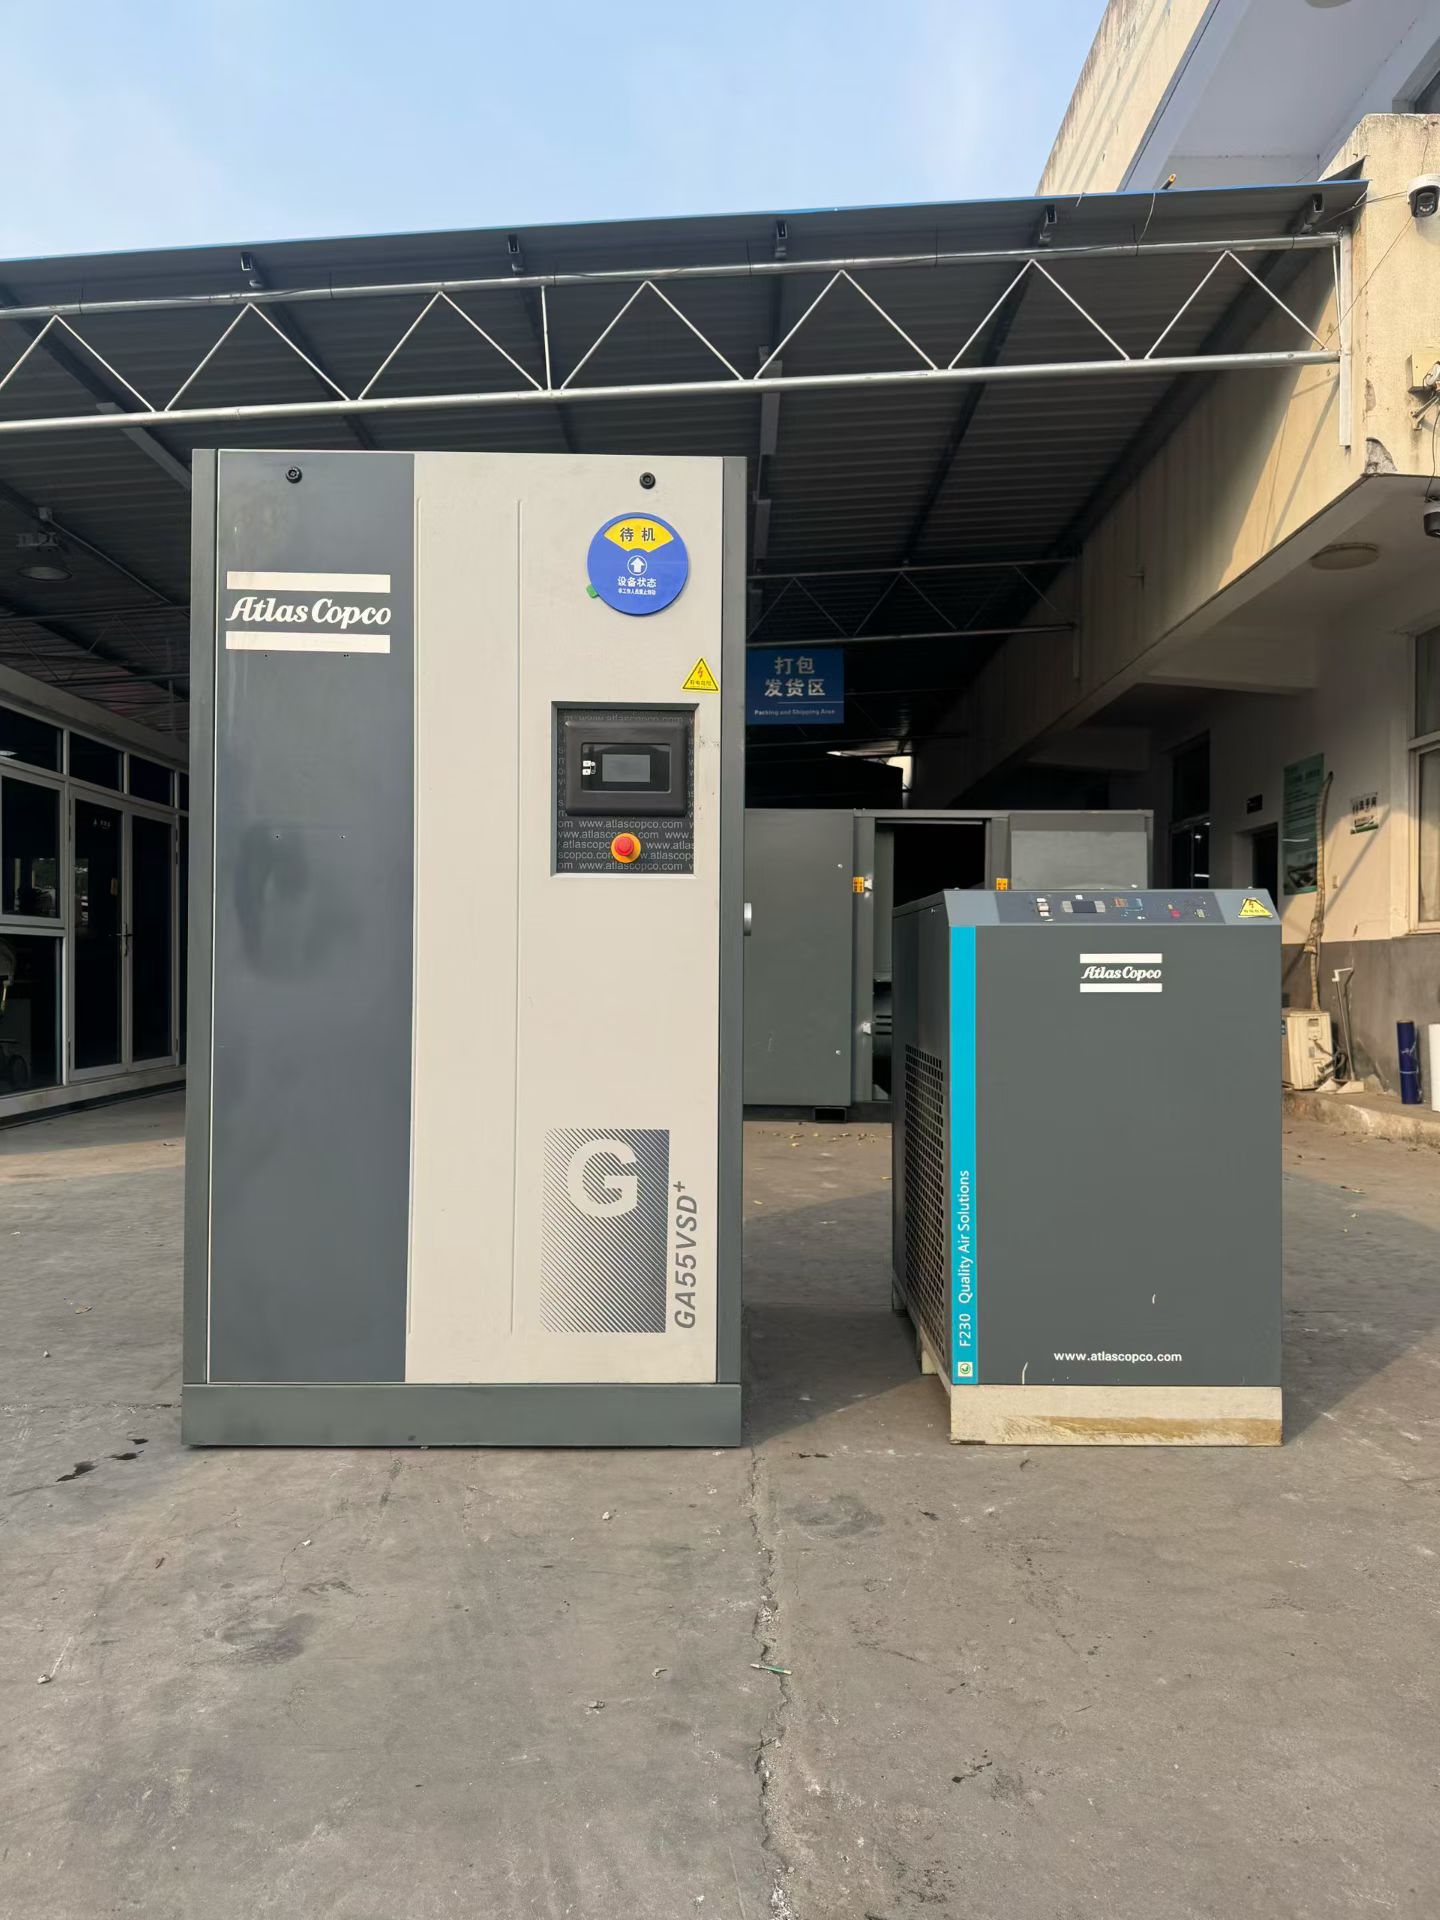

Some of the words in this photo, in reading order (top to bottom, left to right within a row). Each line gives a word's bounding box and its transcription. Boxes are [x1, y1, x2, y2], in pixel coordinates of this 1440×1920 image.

[620, 527, 656, 542] 待机
[617, 576, 657, 588] 设备状态
[225, 596, 309, 623] Atlas
[311, 598, 392, 629] Copco
[774, 656, 815, 674] 打包
[764, 678, 826, 697] 发货区
[579, 819, 683, 830] www.atlascopco.com
[579, 861, 683, 872] www.atlascopco.com
[1081, 966, 1121, 979] Atlas
[1122, 966, 1162, 981] Copco
[566, 1138, 638, 1218] G
[957, 1170, 970, 1232] Solutions
[957, 1236, 970, 1253] Air
[958, 1256, 973, 1304] Quality
[959, 1313, 971, 1347] F230
[1053, 1351, 1182, 1363] www.atlascopco.com
